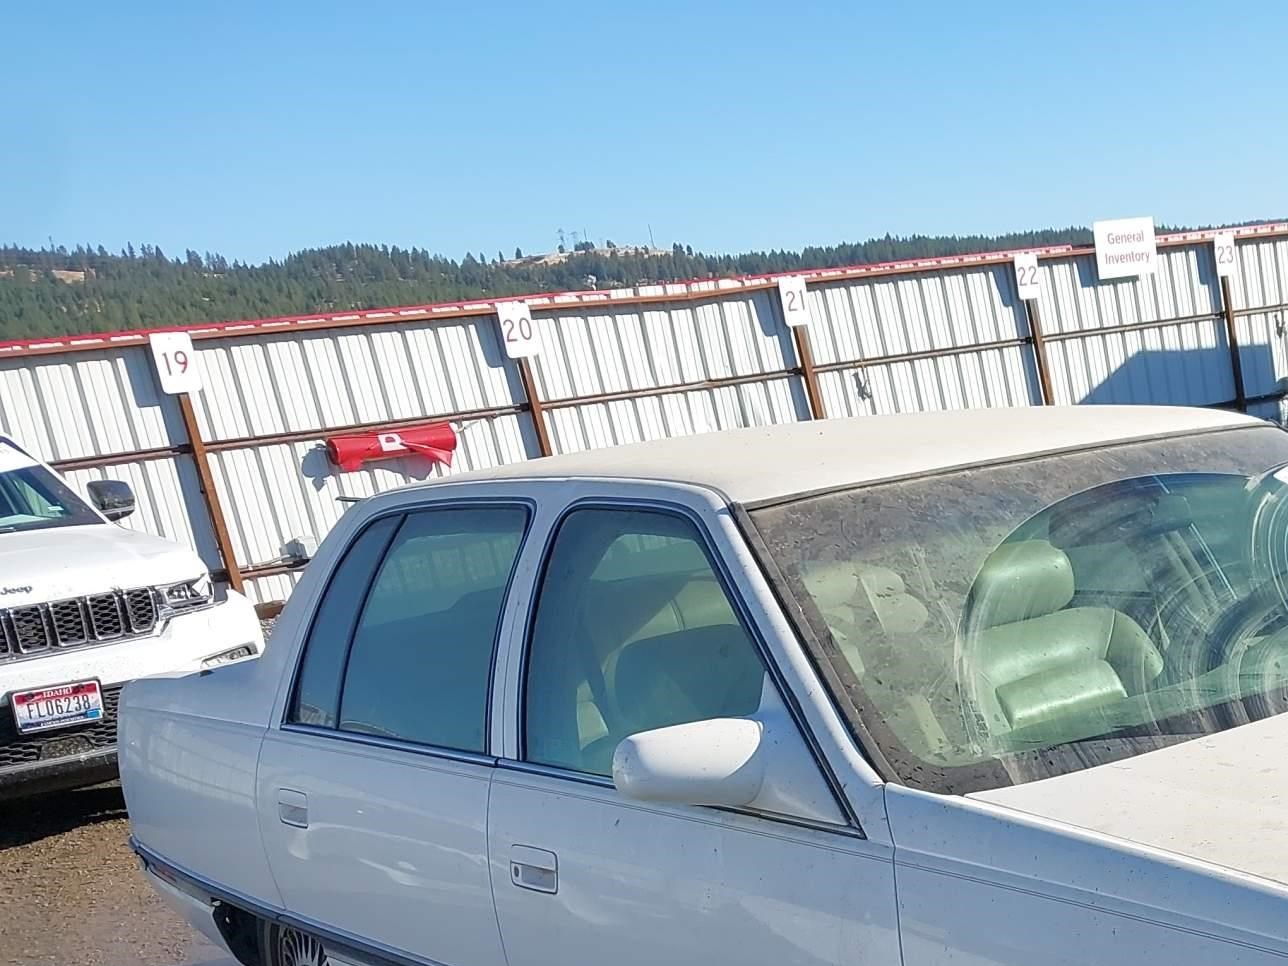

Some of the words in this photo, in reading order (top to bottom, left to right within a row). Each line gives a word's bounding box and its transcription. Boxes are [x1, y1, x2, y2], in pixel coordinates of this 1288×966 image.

[1107, 230, 1144, 245] General
[1105, 250, 1150, 265] Inventory
[1217, 245, 1234, 264] 23
[1018, 265, 1038, 286] 22
[785, 289, 805, 312] 21
[503, 317, 532, 342] 20
[162, 350, 188, 376] 19
[0, 585, 33, 596] Jeep
[43, 687, 74, 699] IDAHO
